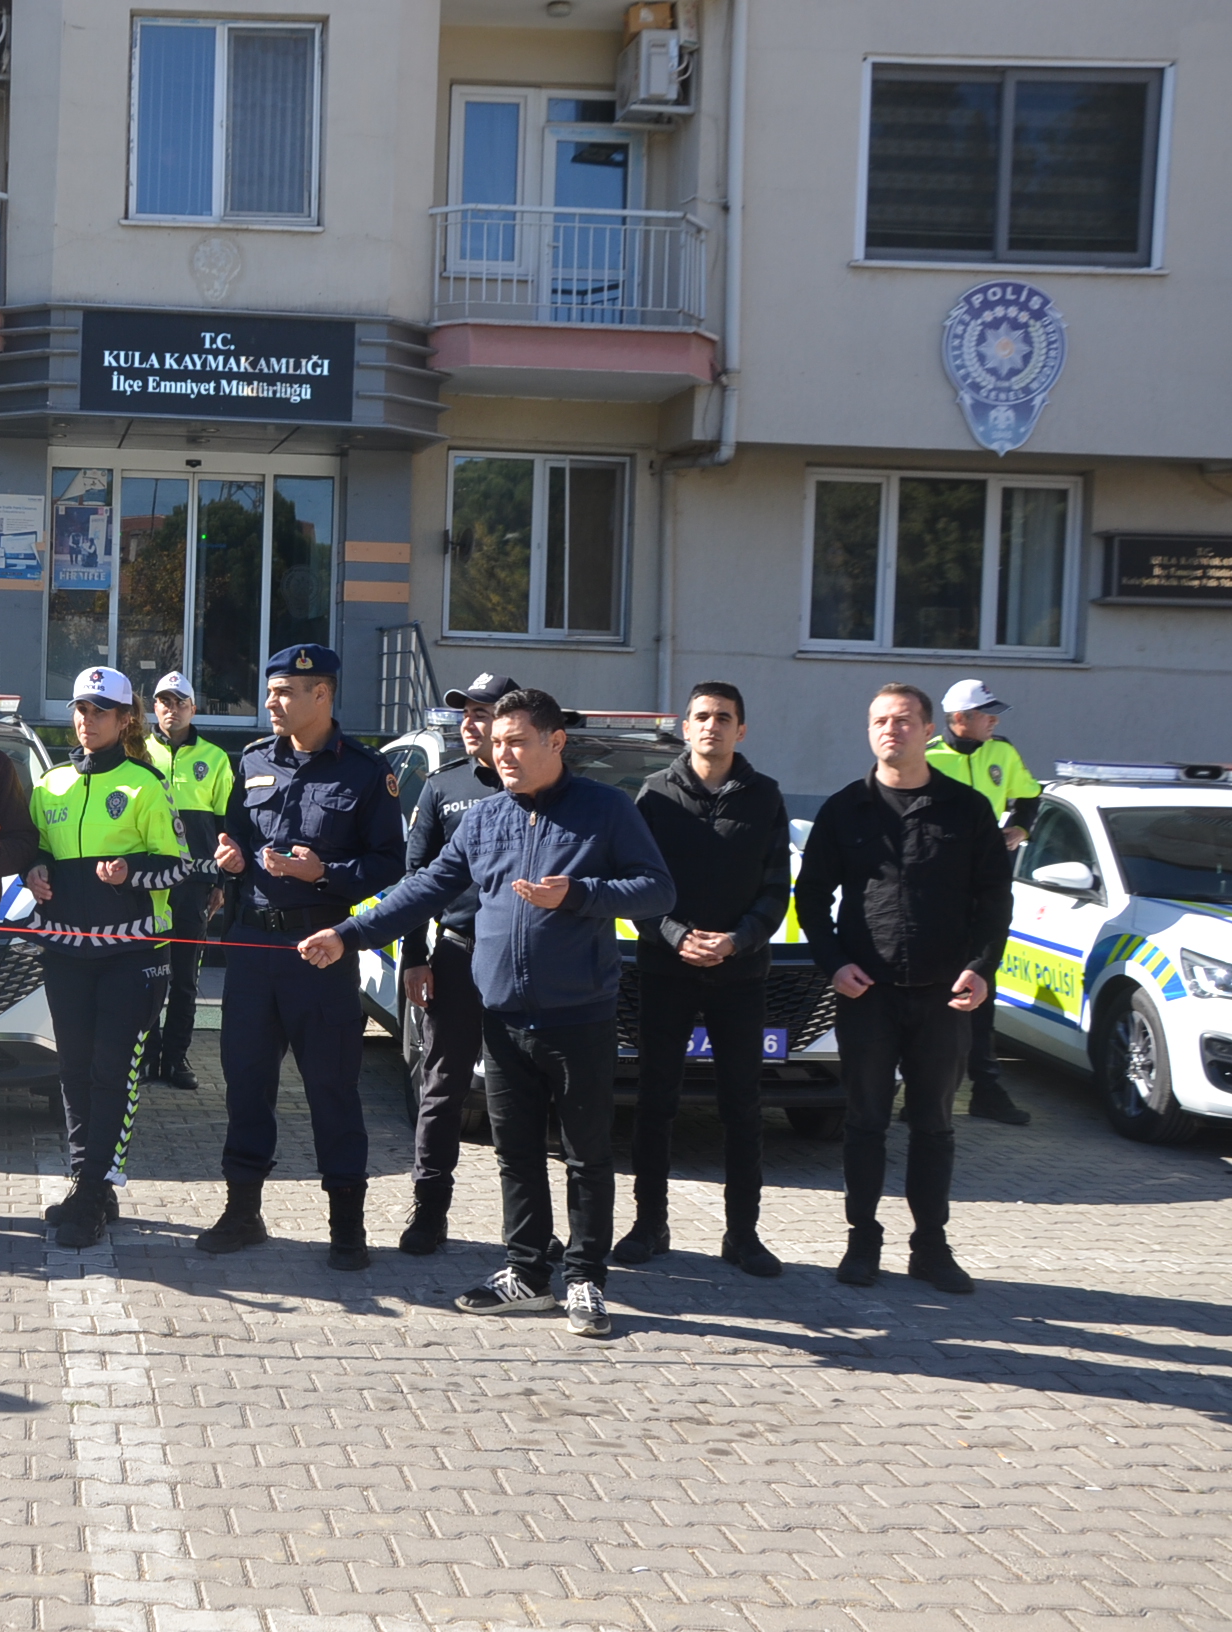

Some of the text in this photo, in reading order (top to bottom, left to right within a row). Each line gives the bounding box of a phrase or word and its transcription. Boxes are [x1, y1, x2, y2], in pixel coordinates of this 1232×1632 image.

[200, 332, 235, 350] T.C.
[102, 350, 330, 376] KULA KAYMAKAMLIĞI
[111, 371, 312, 404] İlçe Emniyet Müdürlüğü
